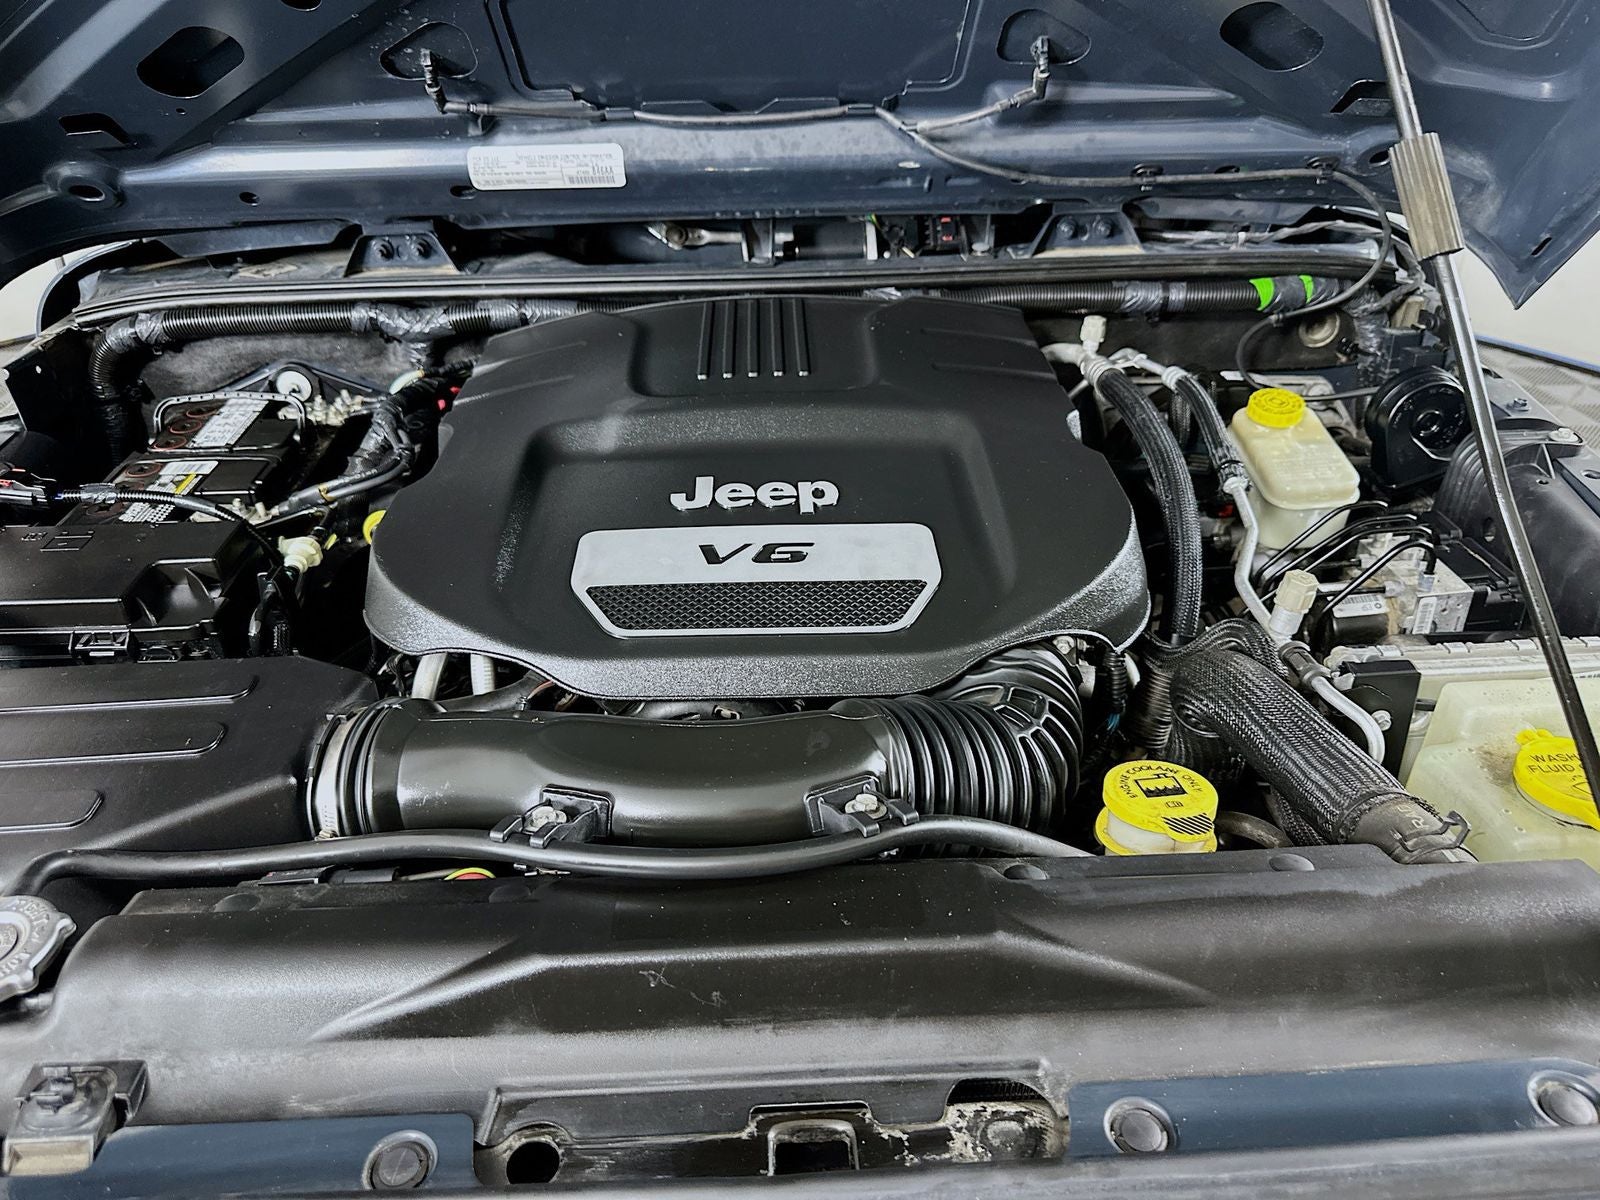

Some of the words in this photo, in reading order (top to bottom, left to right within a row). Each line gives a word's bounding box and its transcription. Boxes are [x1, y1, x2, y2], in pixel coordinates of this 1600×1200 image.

[669, 475, 840, 515] Jeep
[698, 542, 815, 565] V6
[1126, 765, 1179, 775] COOLANT
[1528, 763, 1575, 773] FLUID
[1119, 773, 1138, 799] ENGINE
[1182, 774, 1203, 793] ONLY
